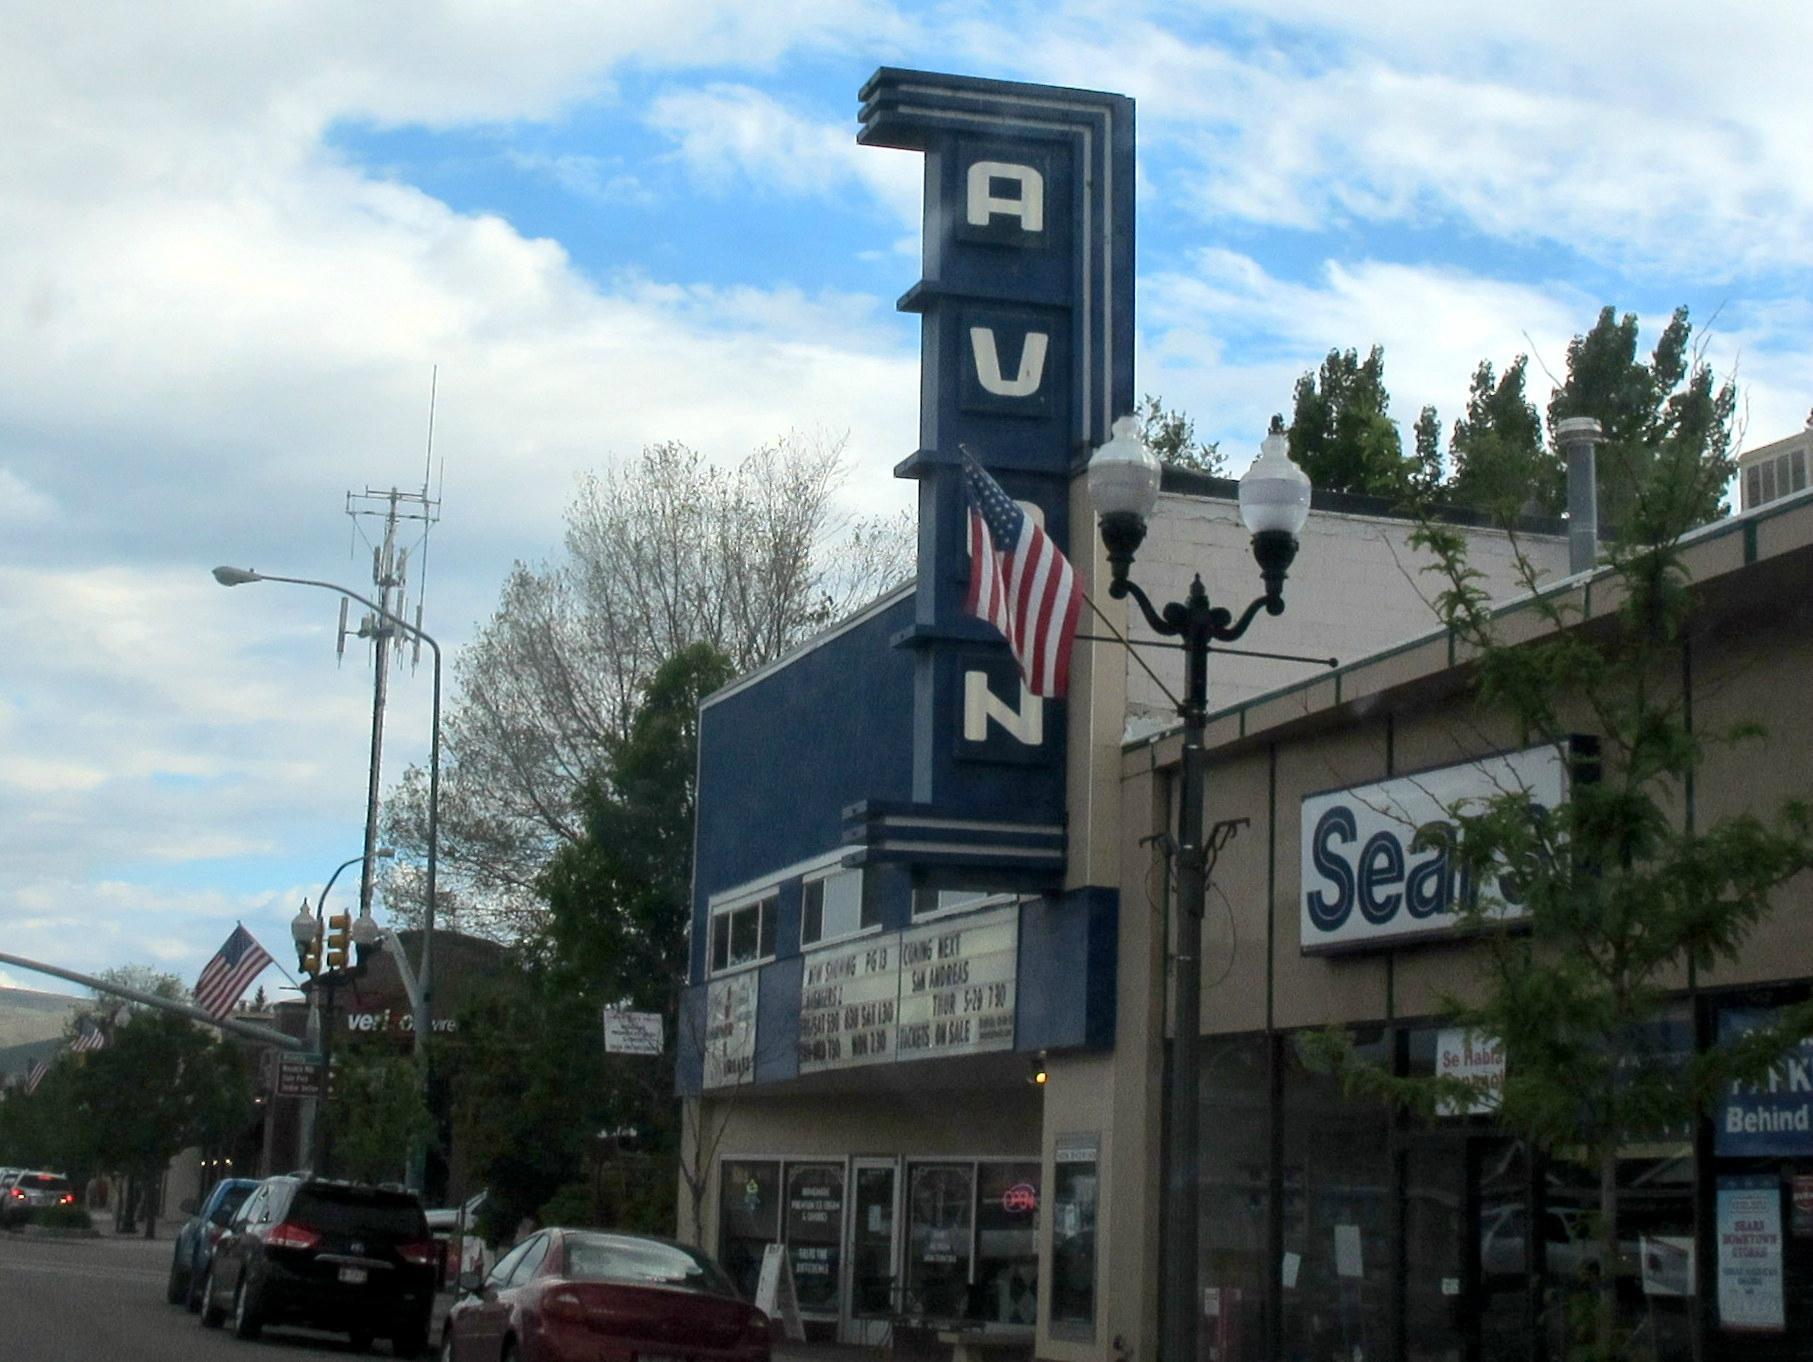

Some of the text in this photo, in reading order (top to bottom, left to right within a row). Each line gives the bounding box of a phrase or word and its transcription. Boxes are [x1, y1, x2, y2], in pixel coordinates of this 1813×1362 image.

[965, 160, 1048, 748] AVN
[937, 933, 961, 959] NEXT
[928, 960, 970, 991] ANDREAS
[347, 1008, 416, 1032] verio
[1442, 1050, 1460, 1068] Se
[1726, 1103, 1809, 1134] Behind
[1004, 1190, 1036, 1211] OPEN
